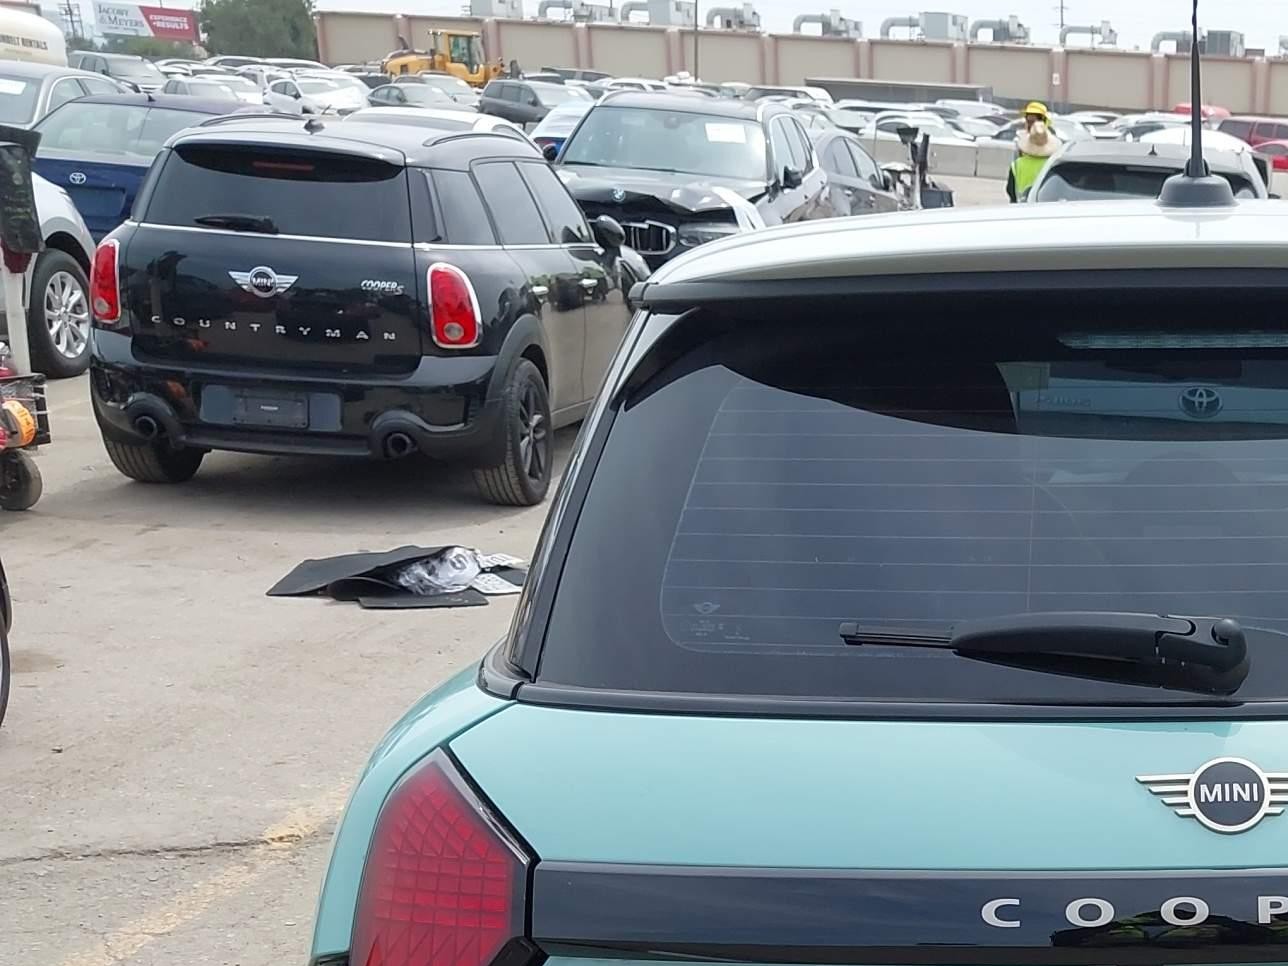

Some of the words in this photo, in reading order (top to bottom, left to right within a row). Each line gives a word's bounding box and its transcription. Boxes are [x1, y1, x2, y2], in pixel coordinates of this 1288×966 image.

[252, 277, 274, 287] MINI
[361, 280, 397, 292] COOPER
[394, 286, 404, 295] S
[151, 314, 396, 340] COUNTRYMAN
[1199, 782, 1259, 803] MINI
